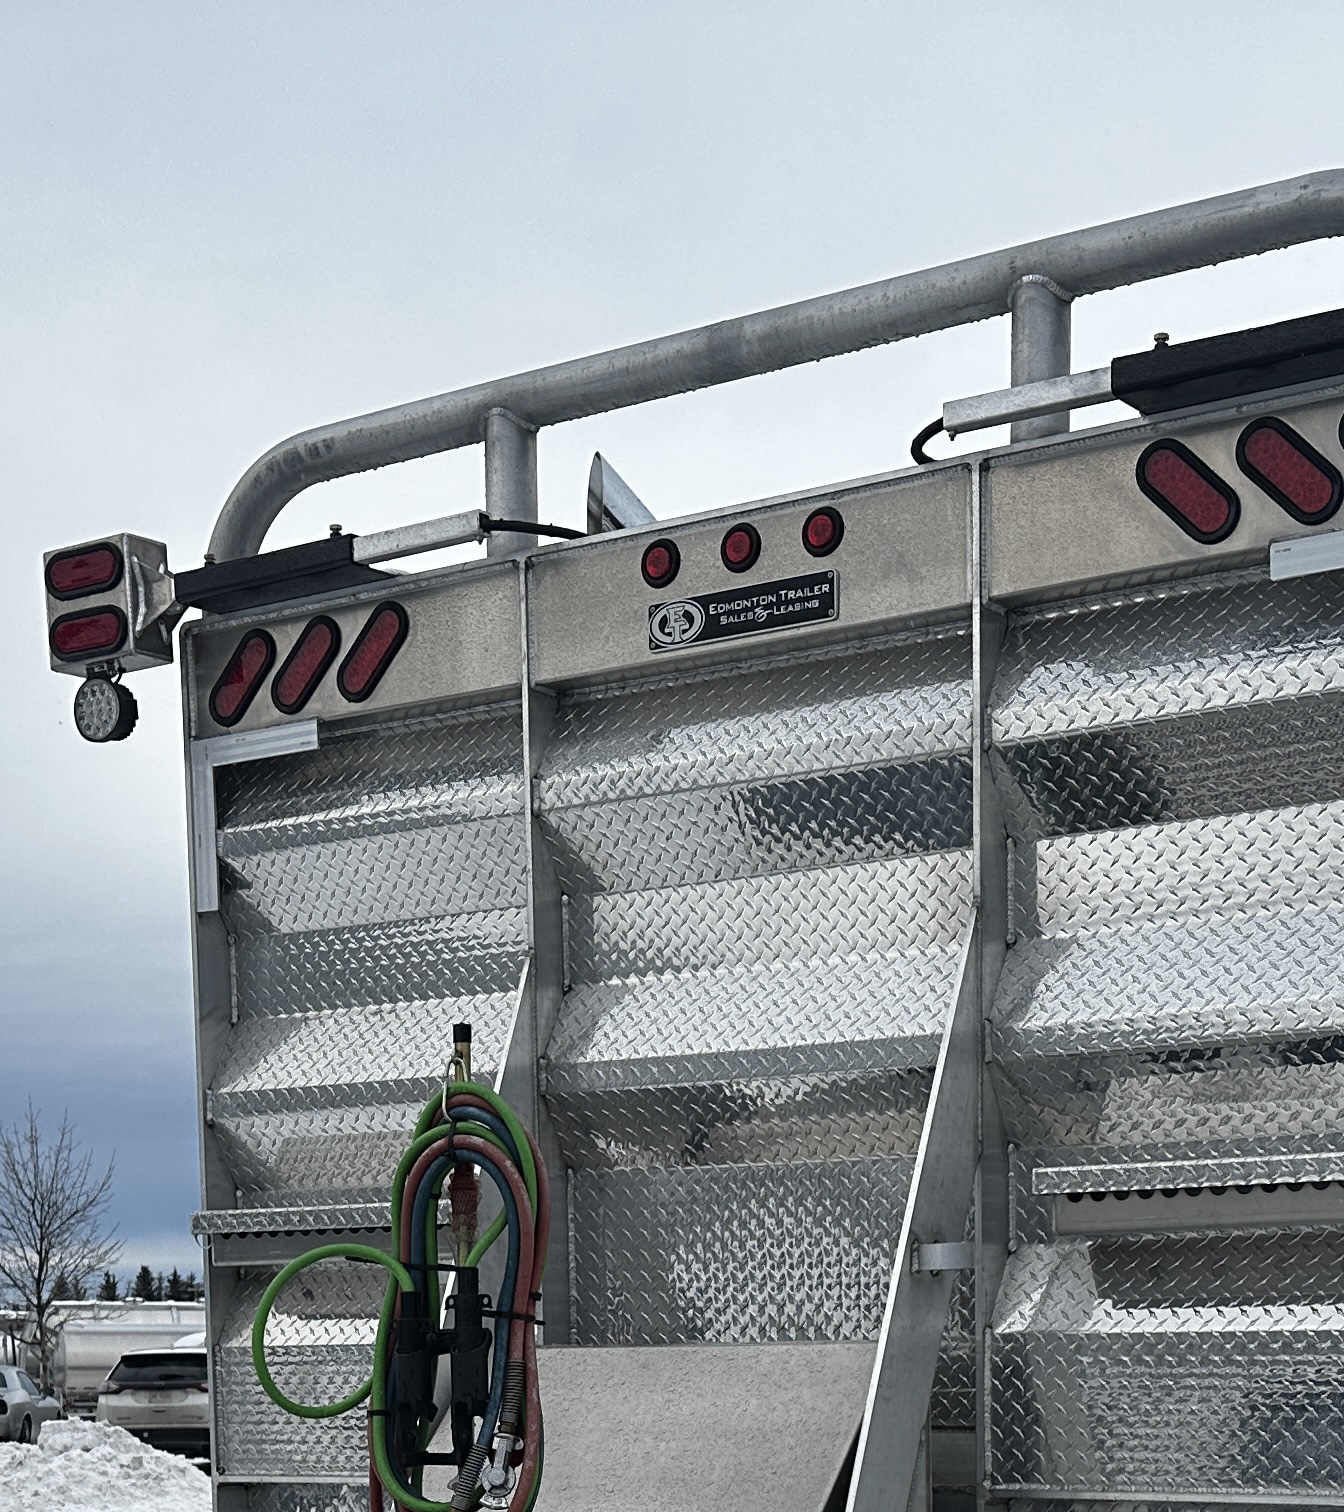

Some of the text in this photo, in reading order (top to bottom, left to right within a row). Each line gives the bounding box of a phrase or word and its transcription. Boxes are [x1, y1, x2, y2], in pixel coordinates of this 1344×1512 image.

[708, 583, 830, 615] EDMONTON TRAILER
[719, 599, 820, 625] SALES & LEASING
